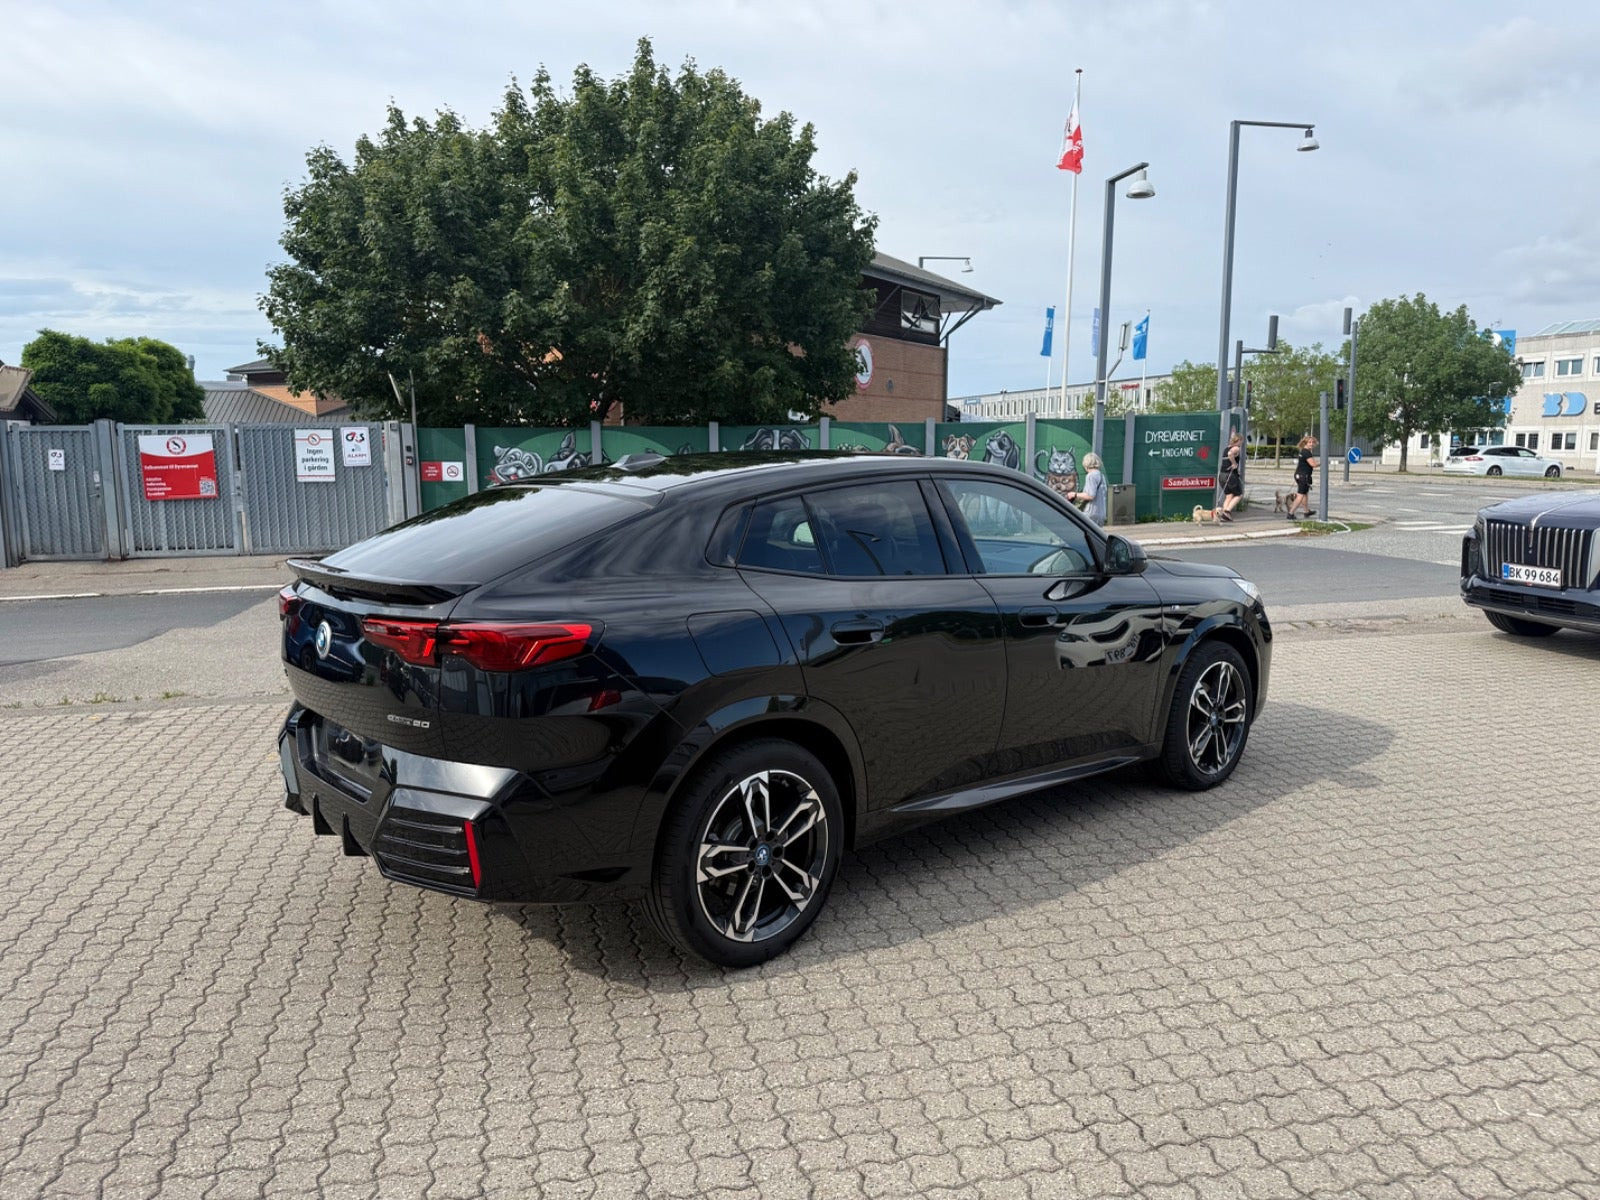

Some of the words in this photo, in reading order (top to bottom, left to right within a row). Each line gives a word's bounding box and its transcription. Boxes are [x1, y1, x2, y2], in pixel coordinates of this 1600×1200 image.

[345, 431, 365, 443] G4S
[1145, 430, 1206, 444] DYREVÆRNET
[1161, 447, 1194, 458] INDGANG
[301, 456, 329, 464] parkering
[307, 464, 328, 472] gården
[1168, 477, 1210, 488] Sandbækvej
[1509, 567, 1522, 579] BK
[1524, 568, 1537, 581] 99
[1539, 570, 1559, 584] 684
